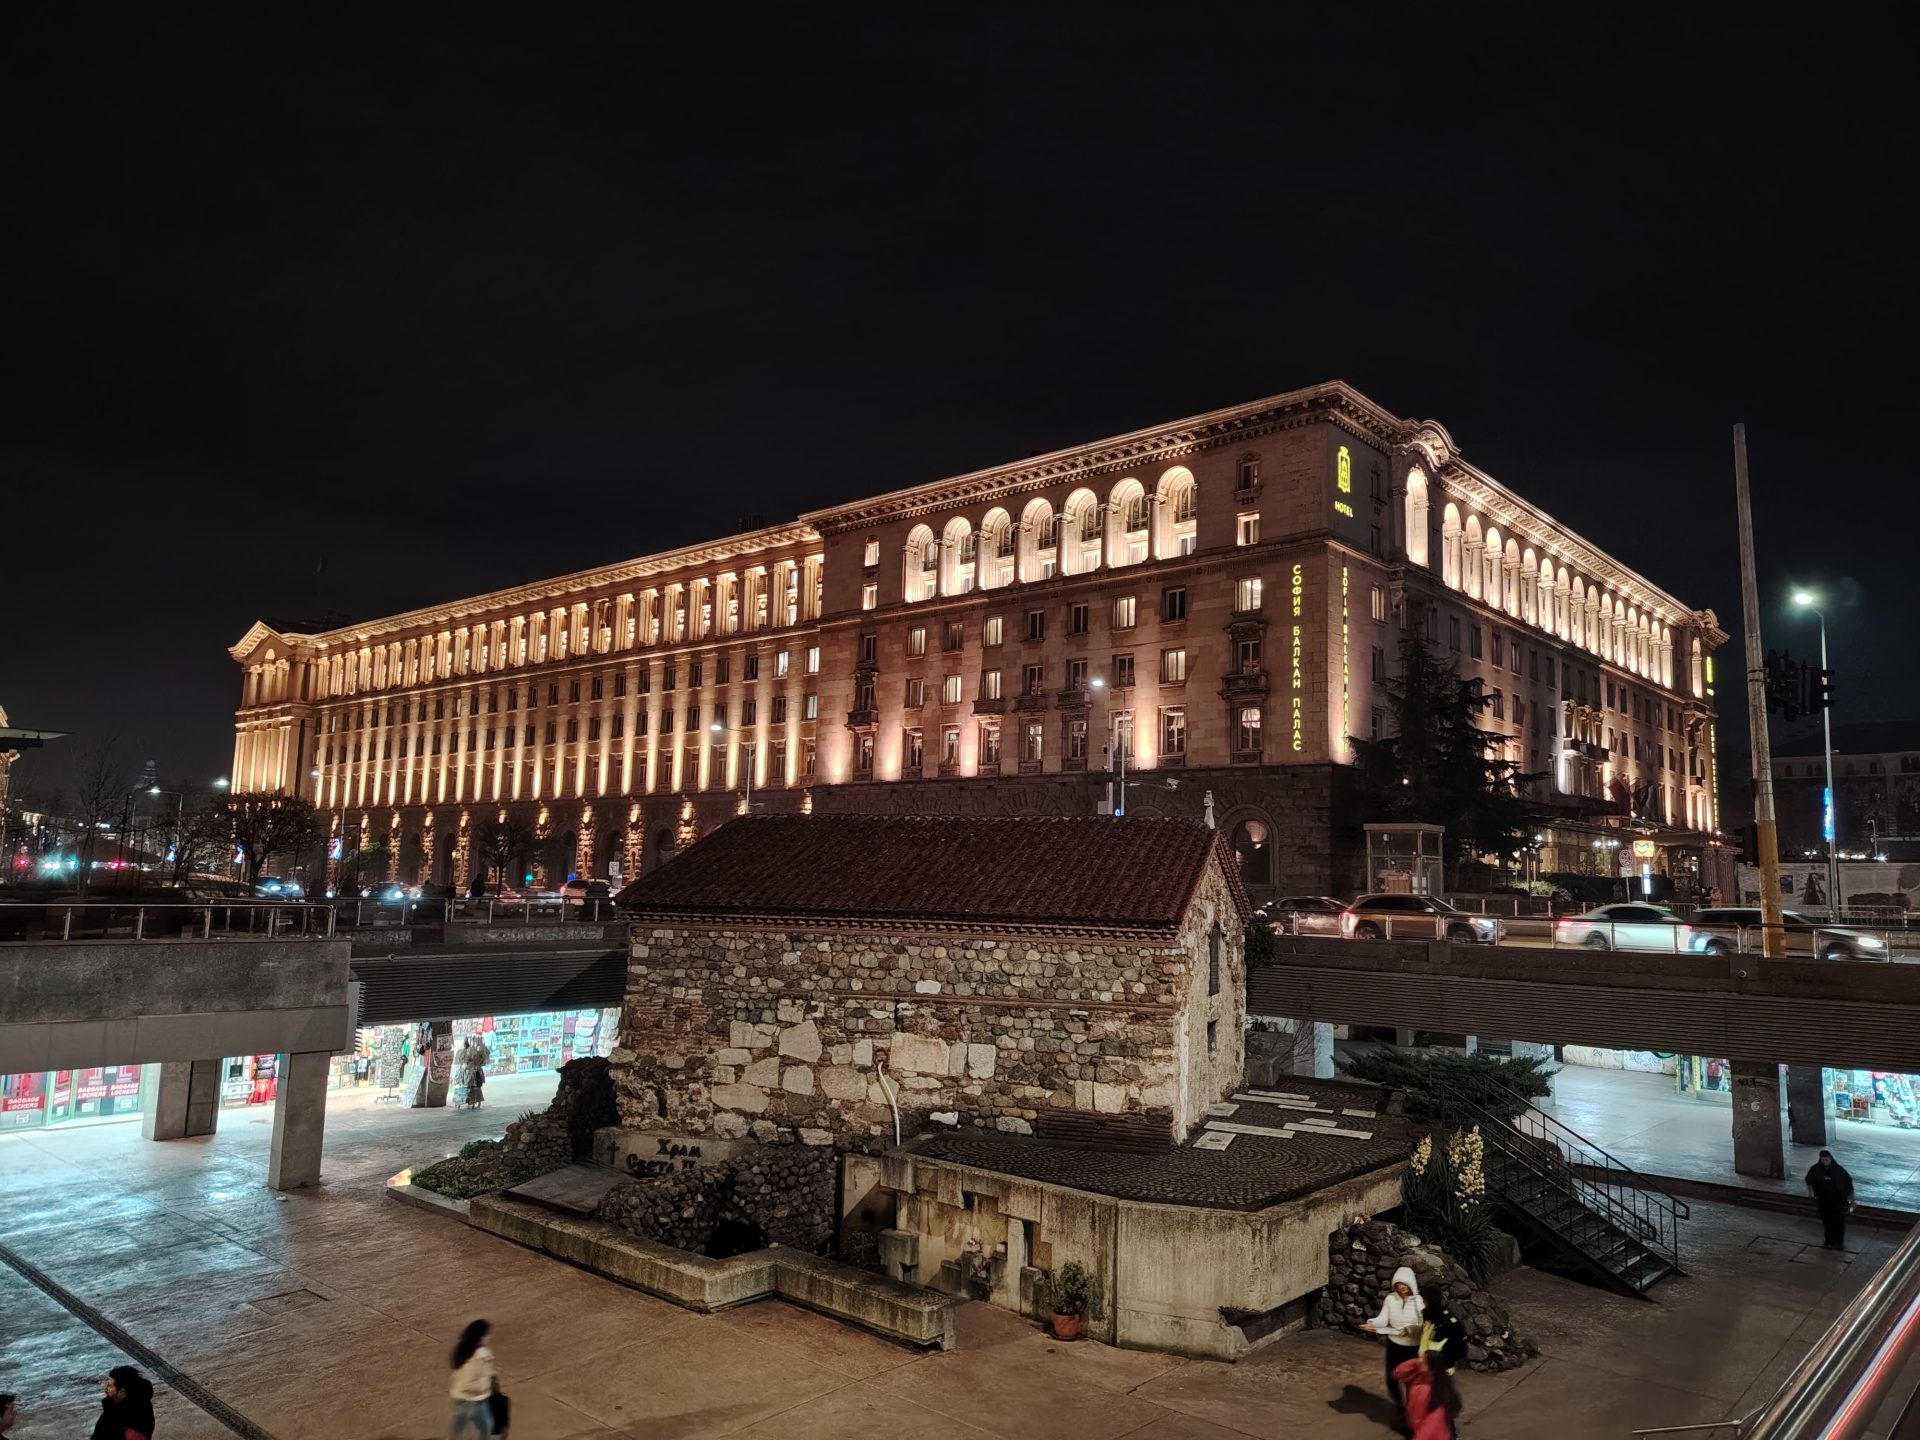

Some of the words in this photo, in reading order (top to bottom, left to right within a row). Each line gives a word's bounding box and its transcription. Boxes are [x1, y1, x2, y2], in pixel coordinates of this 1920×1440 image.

[1334, 500, 1353, 518] HOTEL
[1292, 564, 1302, 617] СОФИЯ
[1292, 625, 1301, 689] БАЛКАН
[1292, 697, 1302, 751] ПАЛАС
[78, 1085, 107, 1093] BAGGAGE
[110, 1088, 138, 1096] LOCKERS
[77, 1091, 106, 1099] LOCKERS
[8, 1096, 39, 1104] BAGGAGE
[7, 1102, 39, 1110] LOCKERS
